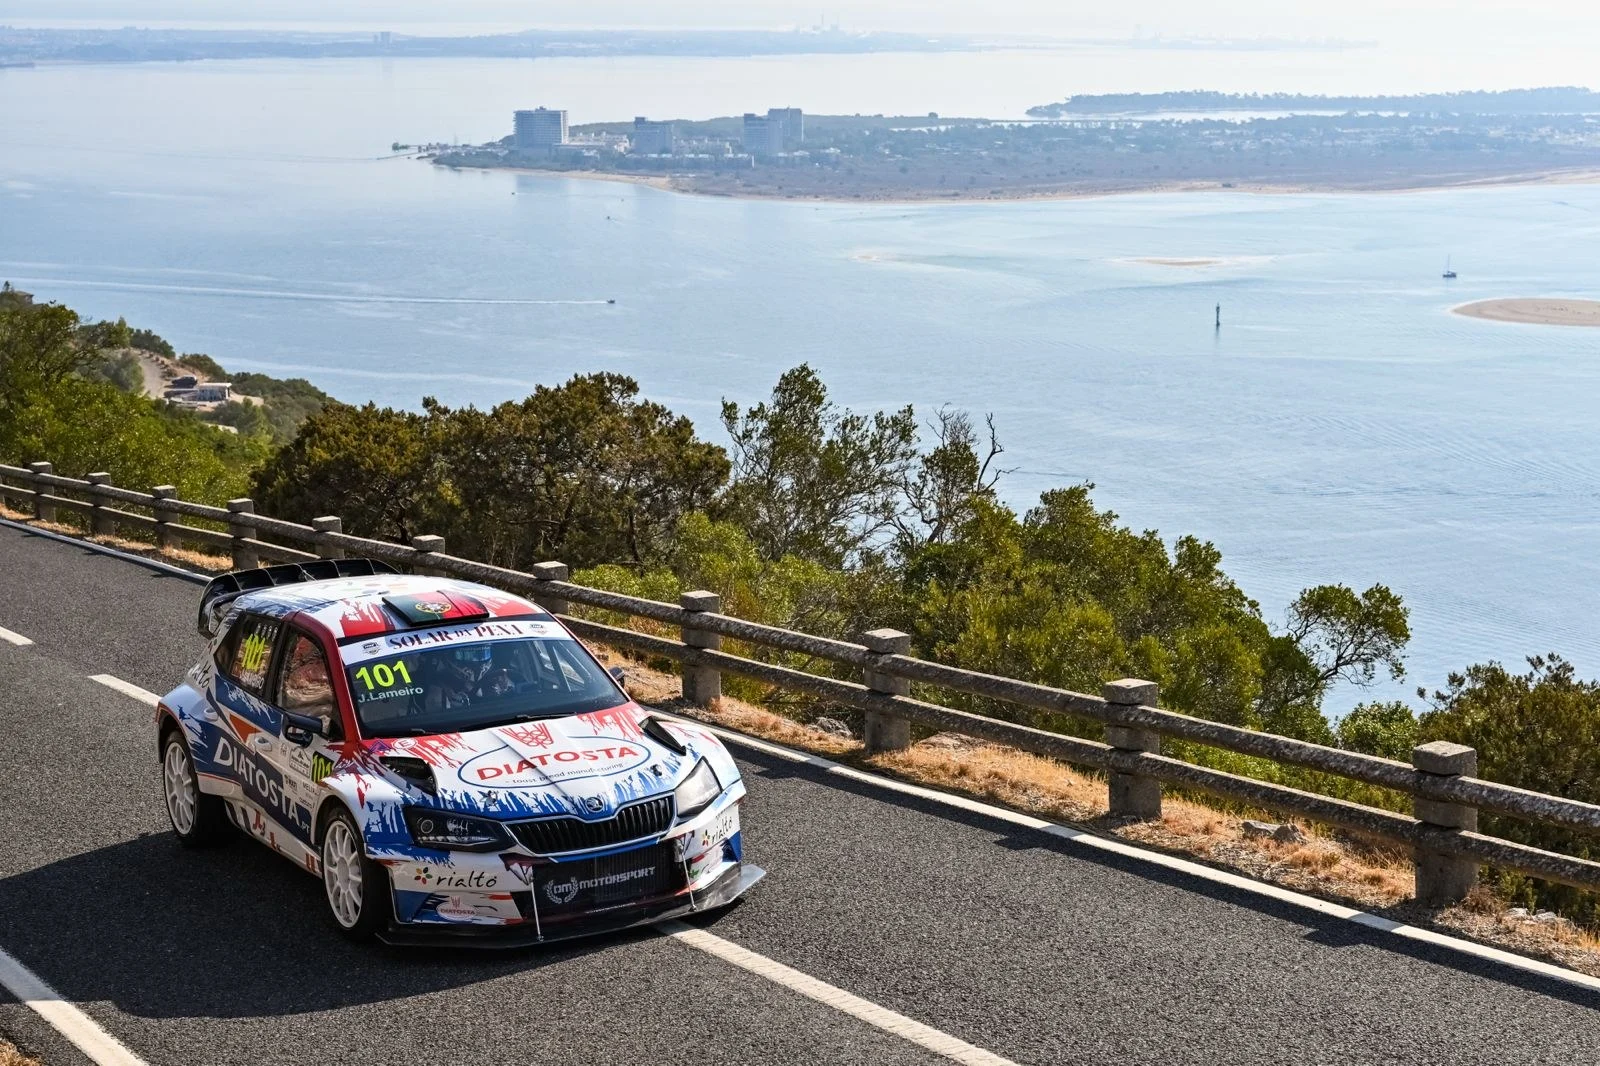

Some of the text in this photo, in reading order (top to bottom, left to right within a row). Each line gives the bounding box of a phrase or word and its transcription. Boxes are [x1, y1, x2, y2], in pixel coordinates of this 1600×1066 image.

[389, 630, 453, 650] SOLAR
[454, 629, 472, 638] DA
[241, 633, 267, 673] 101
[355, 660, 412, 690] 101
[358, 687, 424, 703] J.Lameiro
[476, 746, 639, 780] DIATOSTA
[711, 816, 732, 844] rialto
[436, 870, 497, 888] rialto
[580, 866, 656, 889] MOTORSPORT
